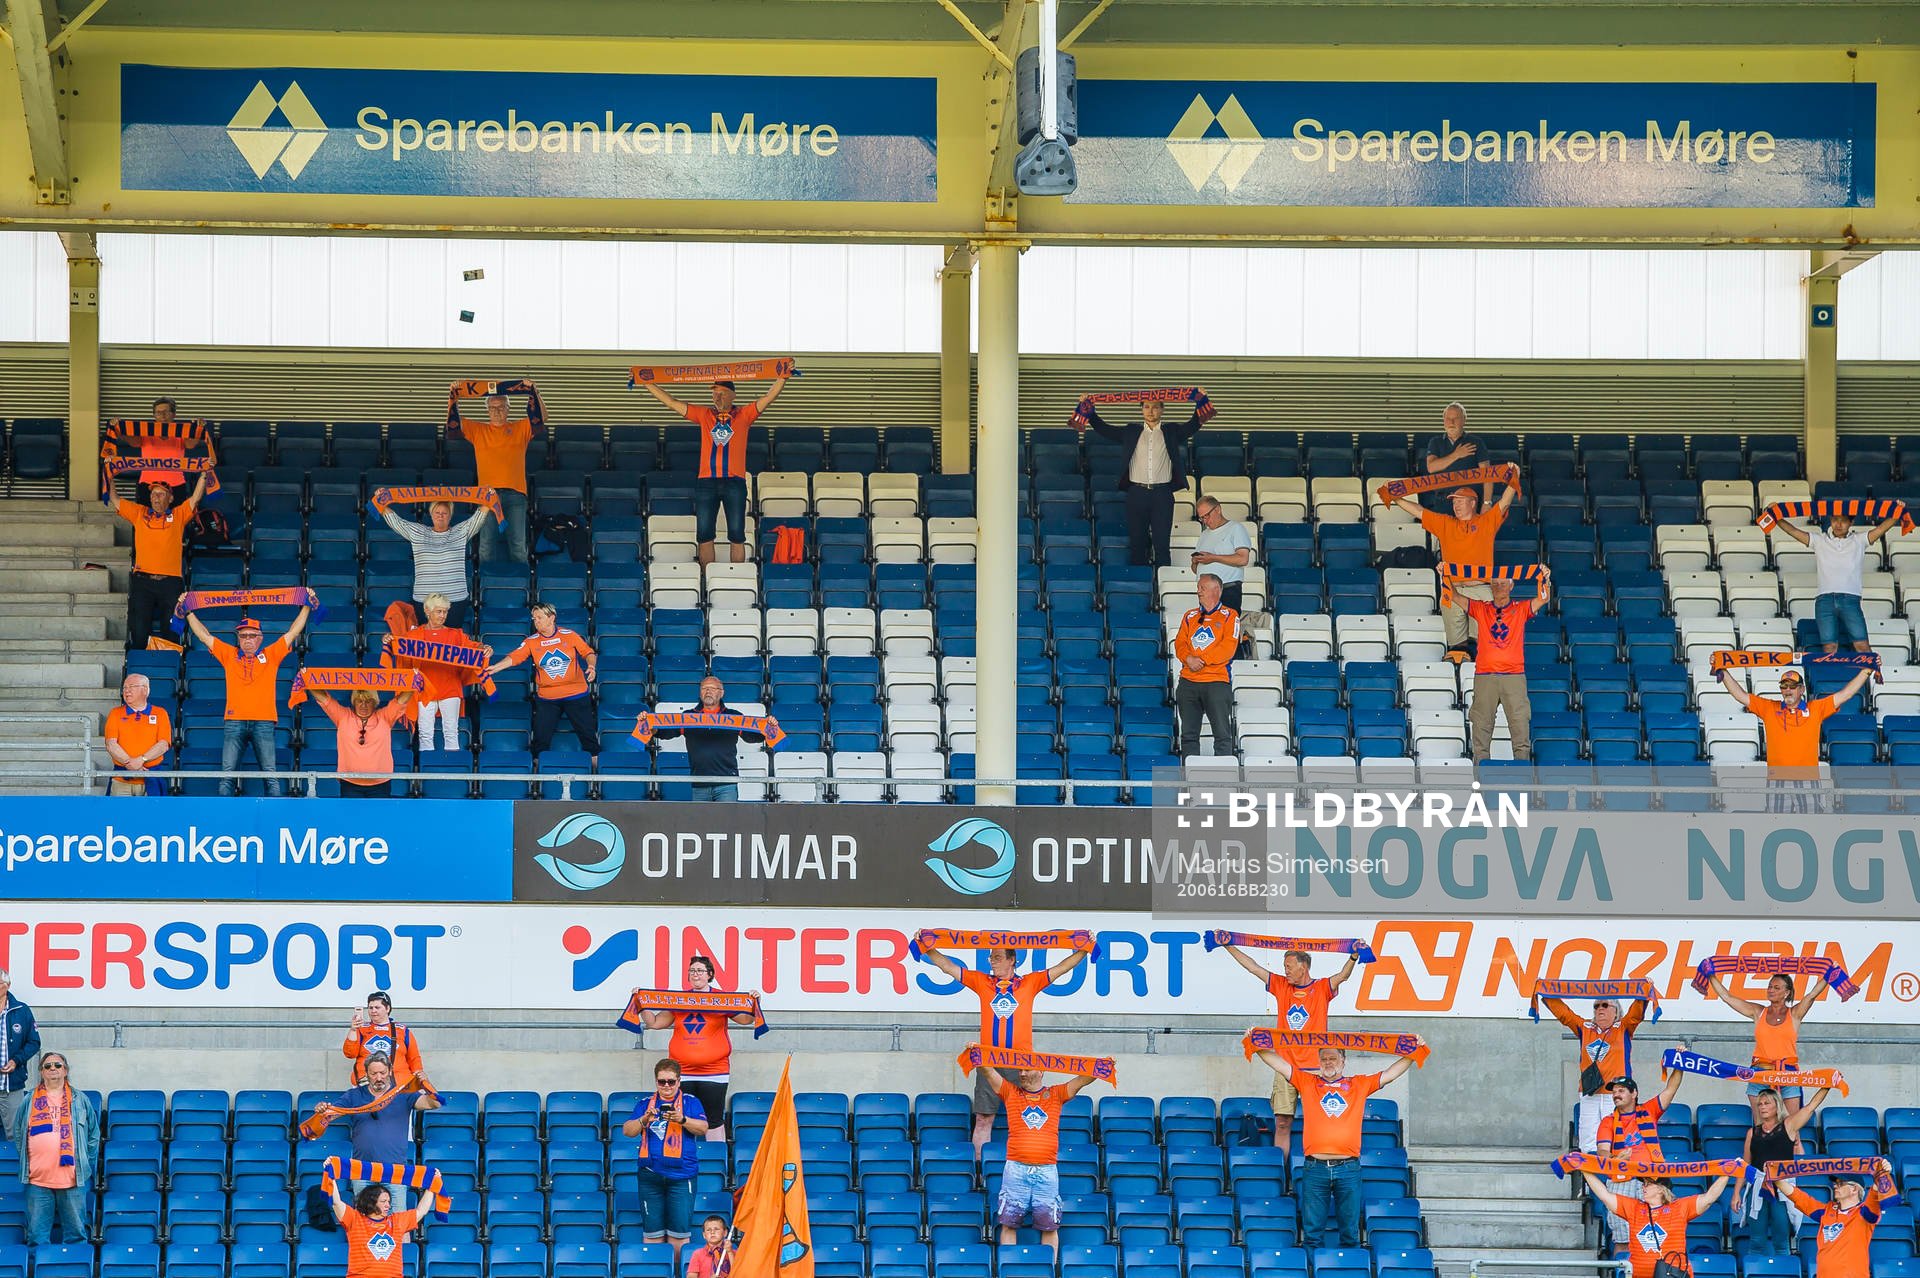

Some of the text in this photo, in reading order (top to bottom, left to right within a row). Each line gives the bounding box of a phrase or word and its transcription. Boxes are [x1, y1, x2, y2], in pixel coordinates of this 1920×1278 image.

[356, 107, 839, 161] Sparebanken Møre
[1291, 118, 1776, 172] Sparebanken Møre
[109, 456, 209, 474] Aalesunds FK
[1410, 470, 1481, 489] AALESUNDS
[397, 487, 471, 499] AALESUNDS
[1722, 652, 1782, 666] AaFK
[308, 671, 387, 686] AALESUNDS
[654, 713, 735, 725] AALESUNDS
[0, 826, 389, 871] parebanken Møre
[642, 833, 857, 880] OPTIMAR
[1295, 825, 1613, 901] NOGVA
[948, 931, 965, 945] Vi
[989, 933, 1058, 946] Stormen
[1541, 981, 1619, 995] AALESUNDS
[1279, 1033, 1365, 1047] AALESUNDS
[988, 1050, 1066, 1070] AALESUNDS
[1672, 1052, 1722, 1075] AaFK
[1763, 1075, 1826, 1085] LEAGUE 2010
[1637, 1161, 1708, 1174] Stormen
[1776, 1157, 1880, 1176] Aalesunds FK
